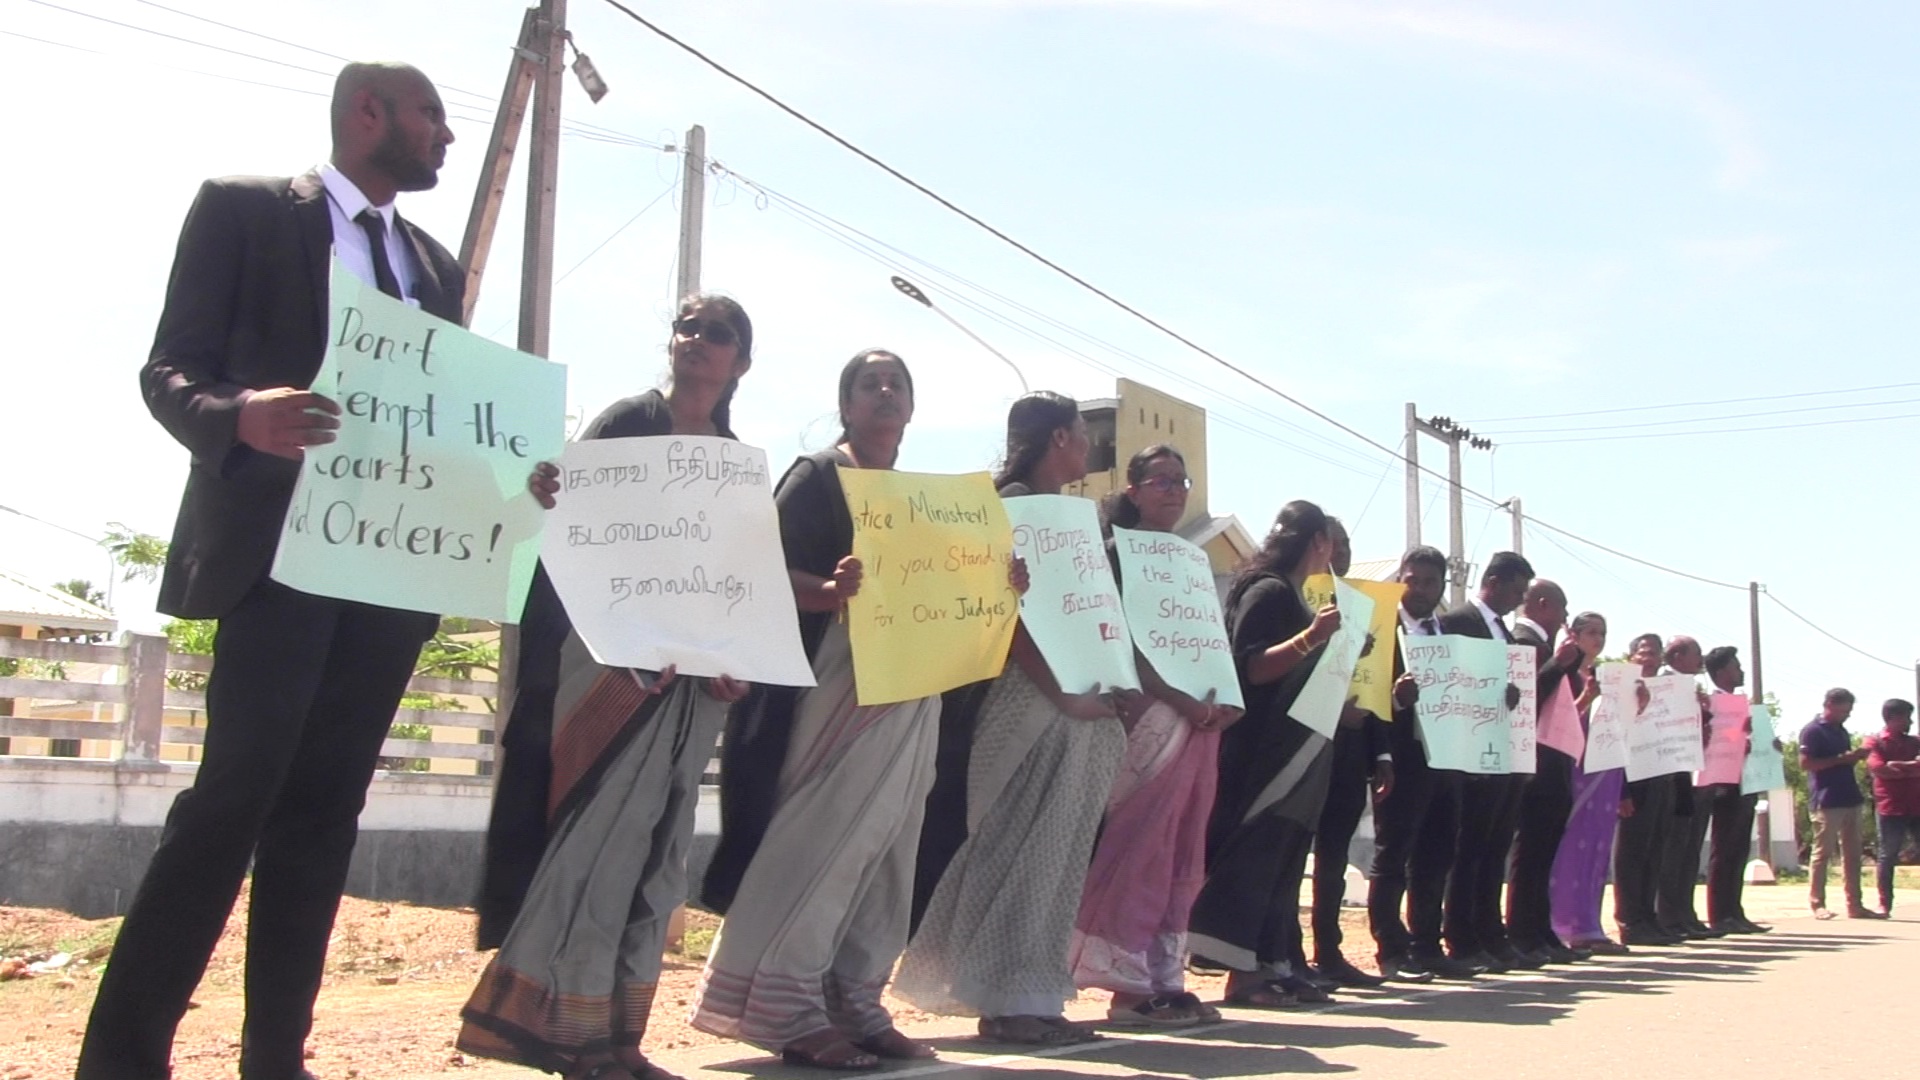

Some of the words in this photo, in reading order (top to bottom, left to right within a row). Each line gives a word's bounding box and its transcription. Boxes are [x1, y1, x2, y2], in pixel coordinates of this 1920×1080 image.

[335, 306, 437, 376] Don't
[464, 400, 530, 458] the
[908, 490, 989, 526] Minister!
[322, 500, 503, 564] Orders!
[899, 556, 935, 586] you
[944, 544, 997, 573] Stand
[1142, 564, 1174, 584] the
[912, 603, 948, 624] Our
